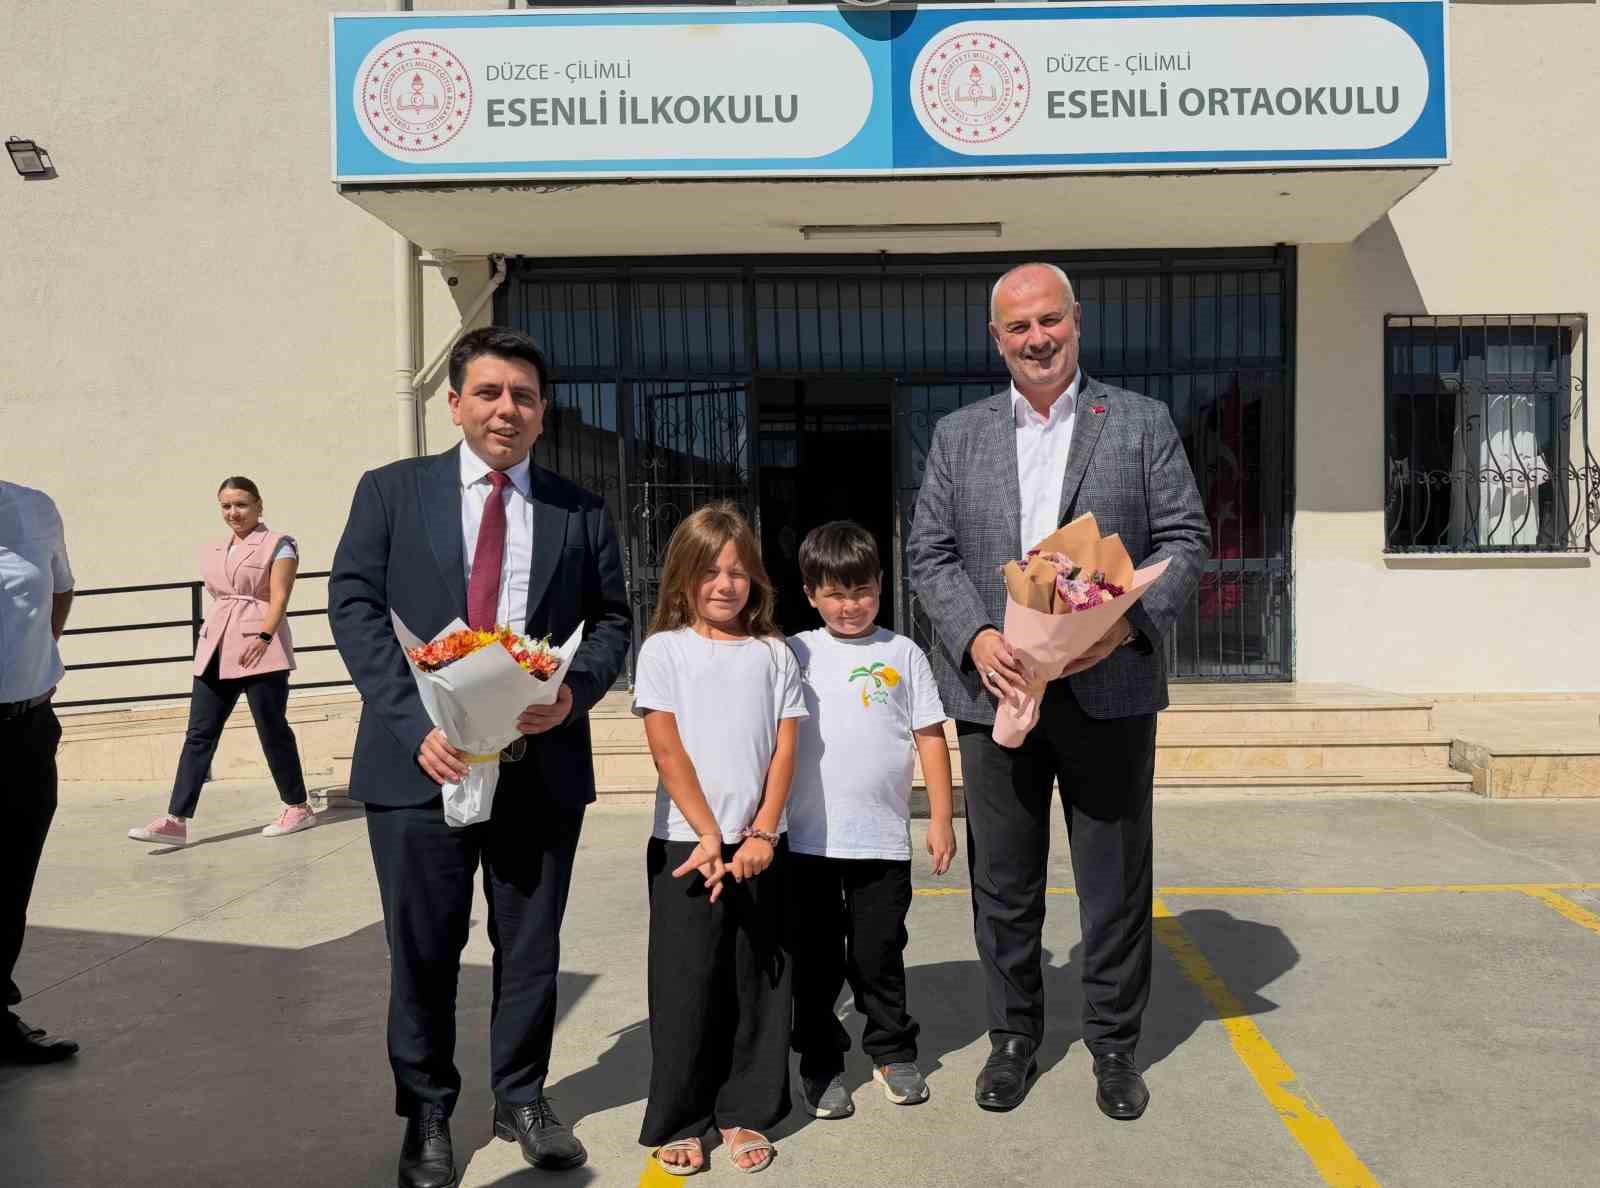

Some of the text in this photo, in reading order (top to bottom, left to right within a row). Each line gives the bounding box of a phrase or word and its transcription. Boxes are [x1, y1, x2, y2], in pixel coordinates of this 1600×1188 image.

[486, 61, 549, 81] DÜZCE
[565, 60, 631, 84] ÇİLİMLİ
[1046, 53, 1110, 73] DÜZCE
[1125, 51, 1191, 75] ÇİLİMLİ
[486, 89, 608, 128] ESENLİ
[618, 89, 798, 125] İLKOKULU
[1046, 81, 1168, 119] ESENLİ
[1178, 85, 1400, 117] ORTAOKULU
